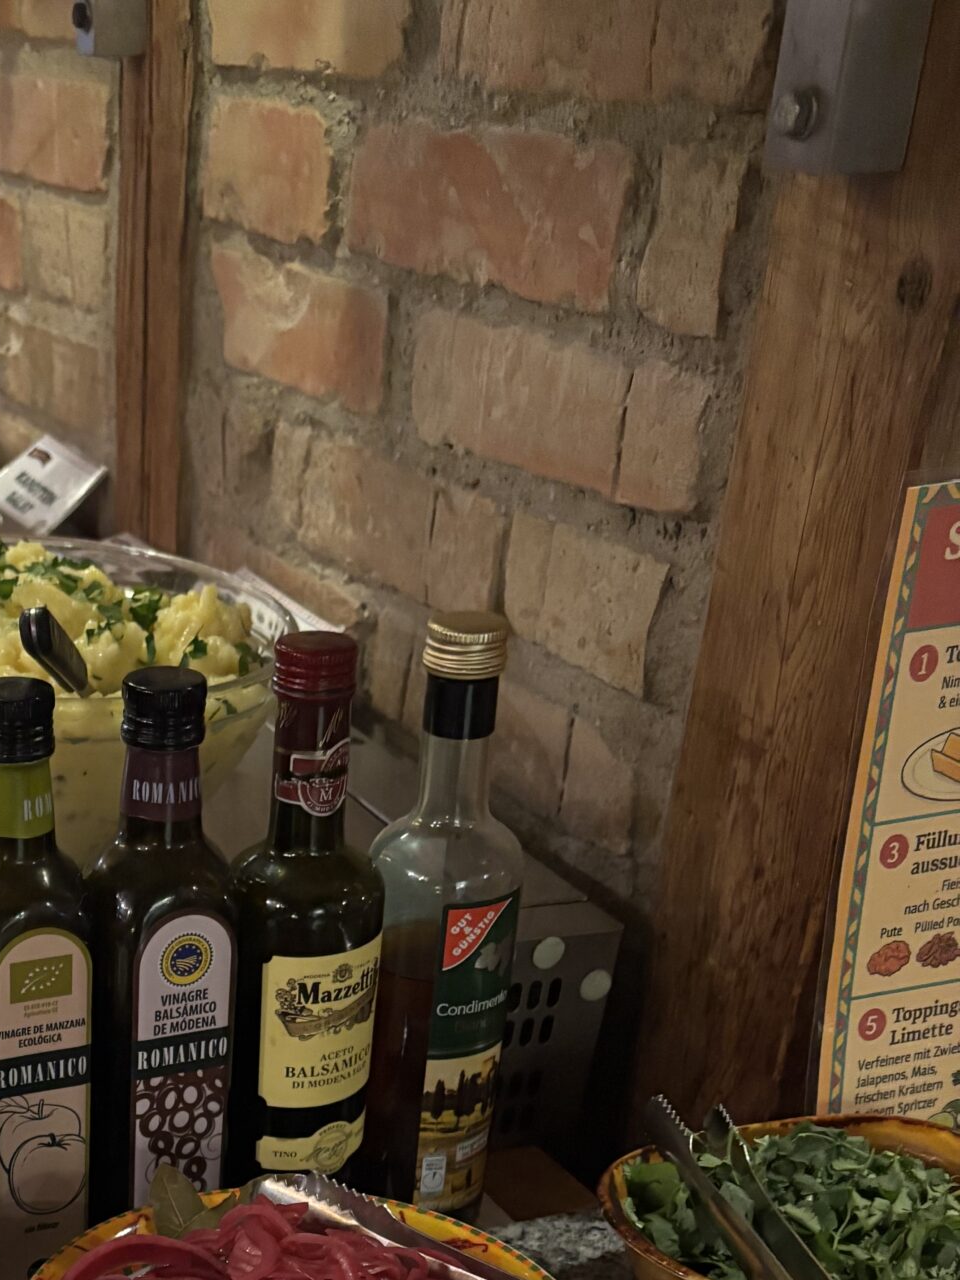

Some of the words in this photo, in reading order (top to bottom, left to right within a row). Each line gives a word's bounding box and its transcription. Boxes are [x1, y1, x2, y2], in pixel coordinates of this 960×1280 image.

[938, 695, 947, 709] &
[887, 842, 900, 863] 3
[914, 830, 960, 852] Füllu
[904, 900, 929, 915] nach
[451, 913, 472, 935] GUT
[452, 911, 496, 956] GÜNSTIG
[880, 927, 902, 939] Pute
[161, 988, 208, 1007] VINAGRE
[154, 1001, 217, 1022] BALSÁMICO
[33, 1024, 44, 1034] DE
[45, 1018, 86, 1033] MANZANA
[153, 1023, 167, 1036] DE
[169, 1015, 217, 1034] MÓDENA
[865, 1015, 878, 1036] 5
[889, 1023, 953, 1046] Limette
[18, 1033, 63, 1048] ECOLÓGICA
[137, 1036, 227, 1071] ROMANICO
[285, 1043, 371, 1079] BALSAMICO
[320, 1045, 354, 1062] ACETO
[858, 1053, 911, 1071] Verfeinere
[913, 1049, 931, 1060] mit
[292, 1081, 305, 1089] DI
[308, 1071, 352, 1088] MODENA
[911, 1064, 938, 1079] Mais,
[855, 1088, 896, 1106] frischen
[898, 1081, 944, 1098] Kräutern
[897, 1098, 938, 1115] Spritzer
